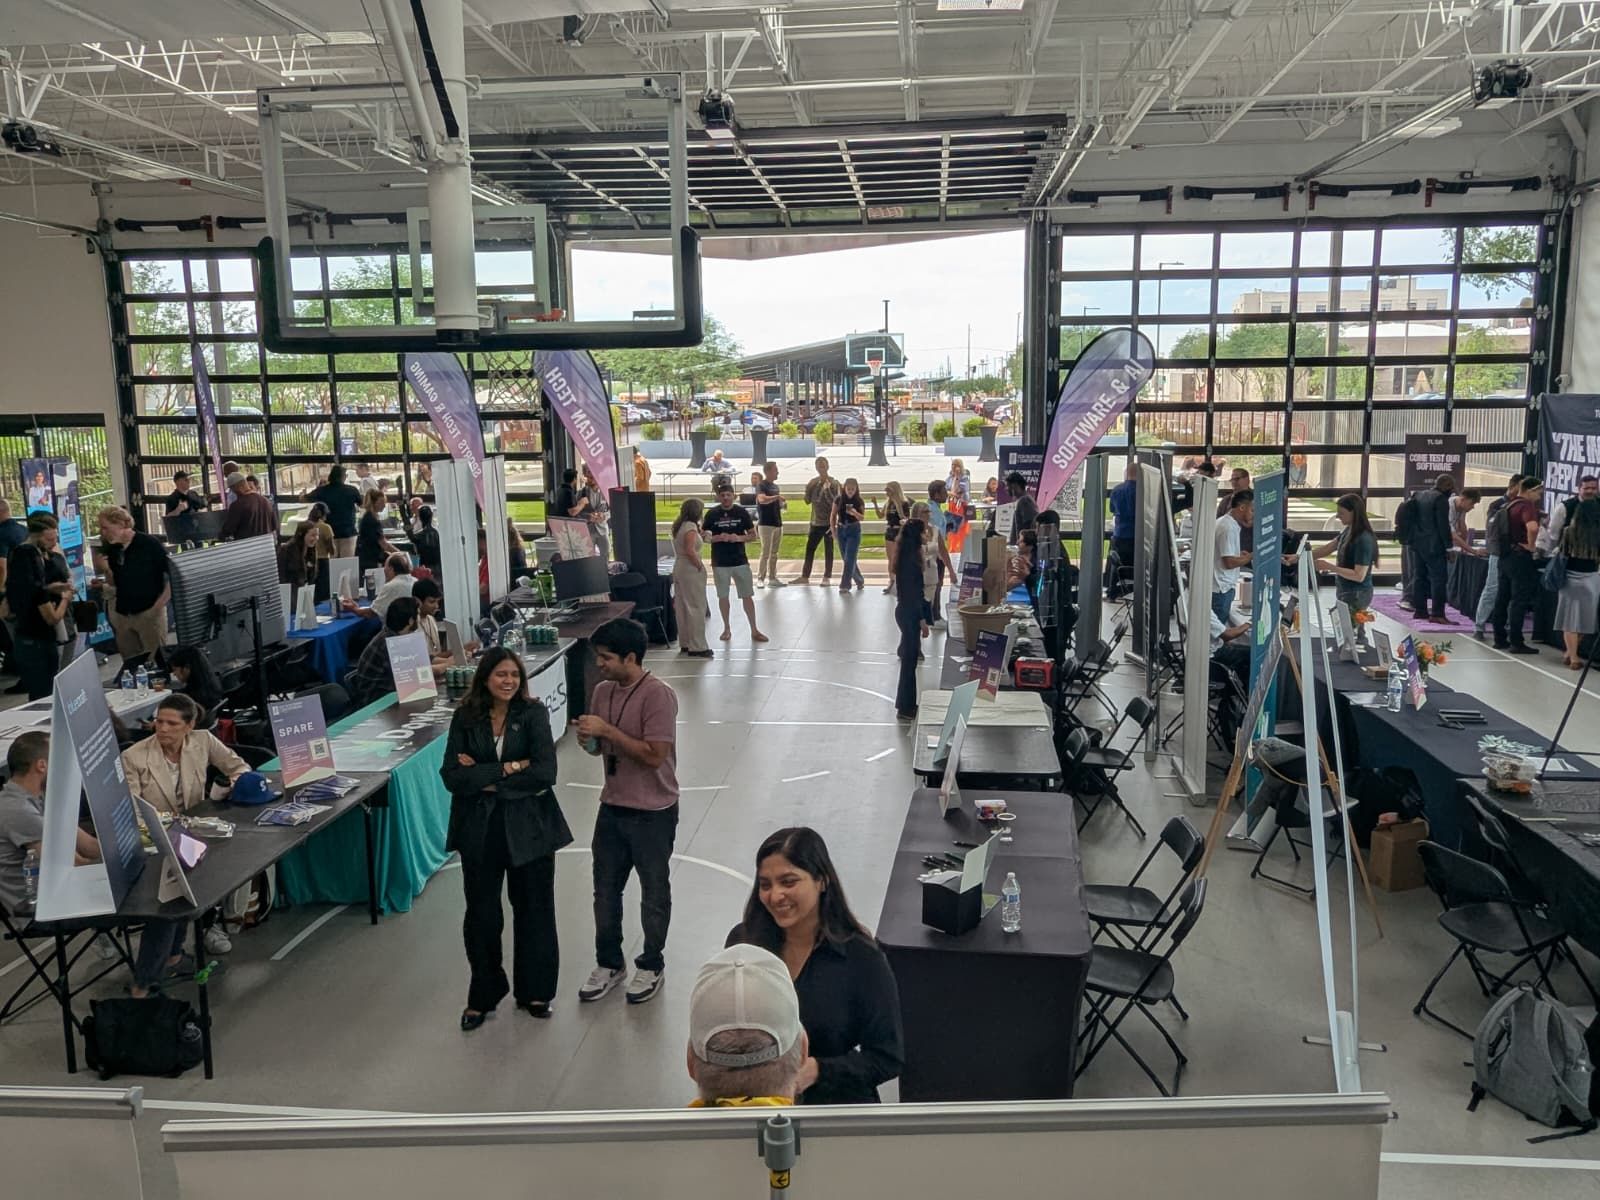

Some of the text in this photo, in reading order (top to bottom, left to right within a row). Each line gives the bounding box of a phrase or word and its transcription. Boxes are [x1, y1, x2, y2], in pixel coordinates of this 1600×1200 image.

[1052, 358, 1145, 470] SOFTWARE & AI
[1429, 453, 1445, 463] TEST
[1446, 454, 1461, 464] OUR
[1416, 462, 1454, 471] SOFTWARE
[279, 721, 315, 737] SPARE
